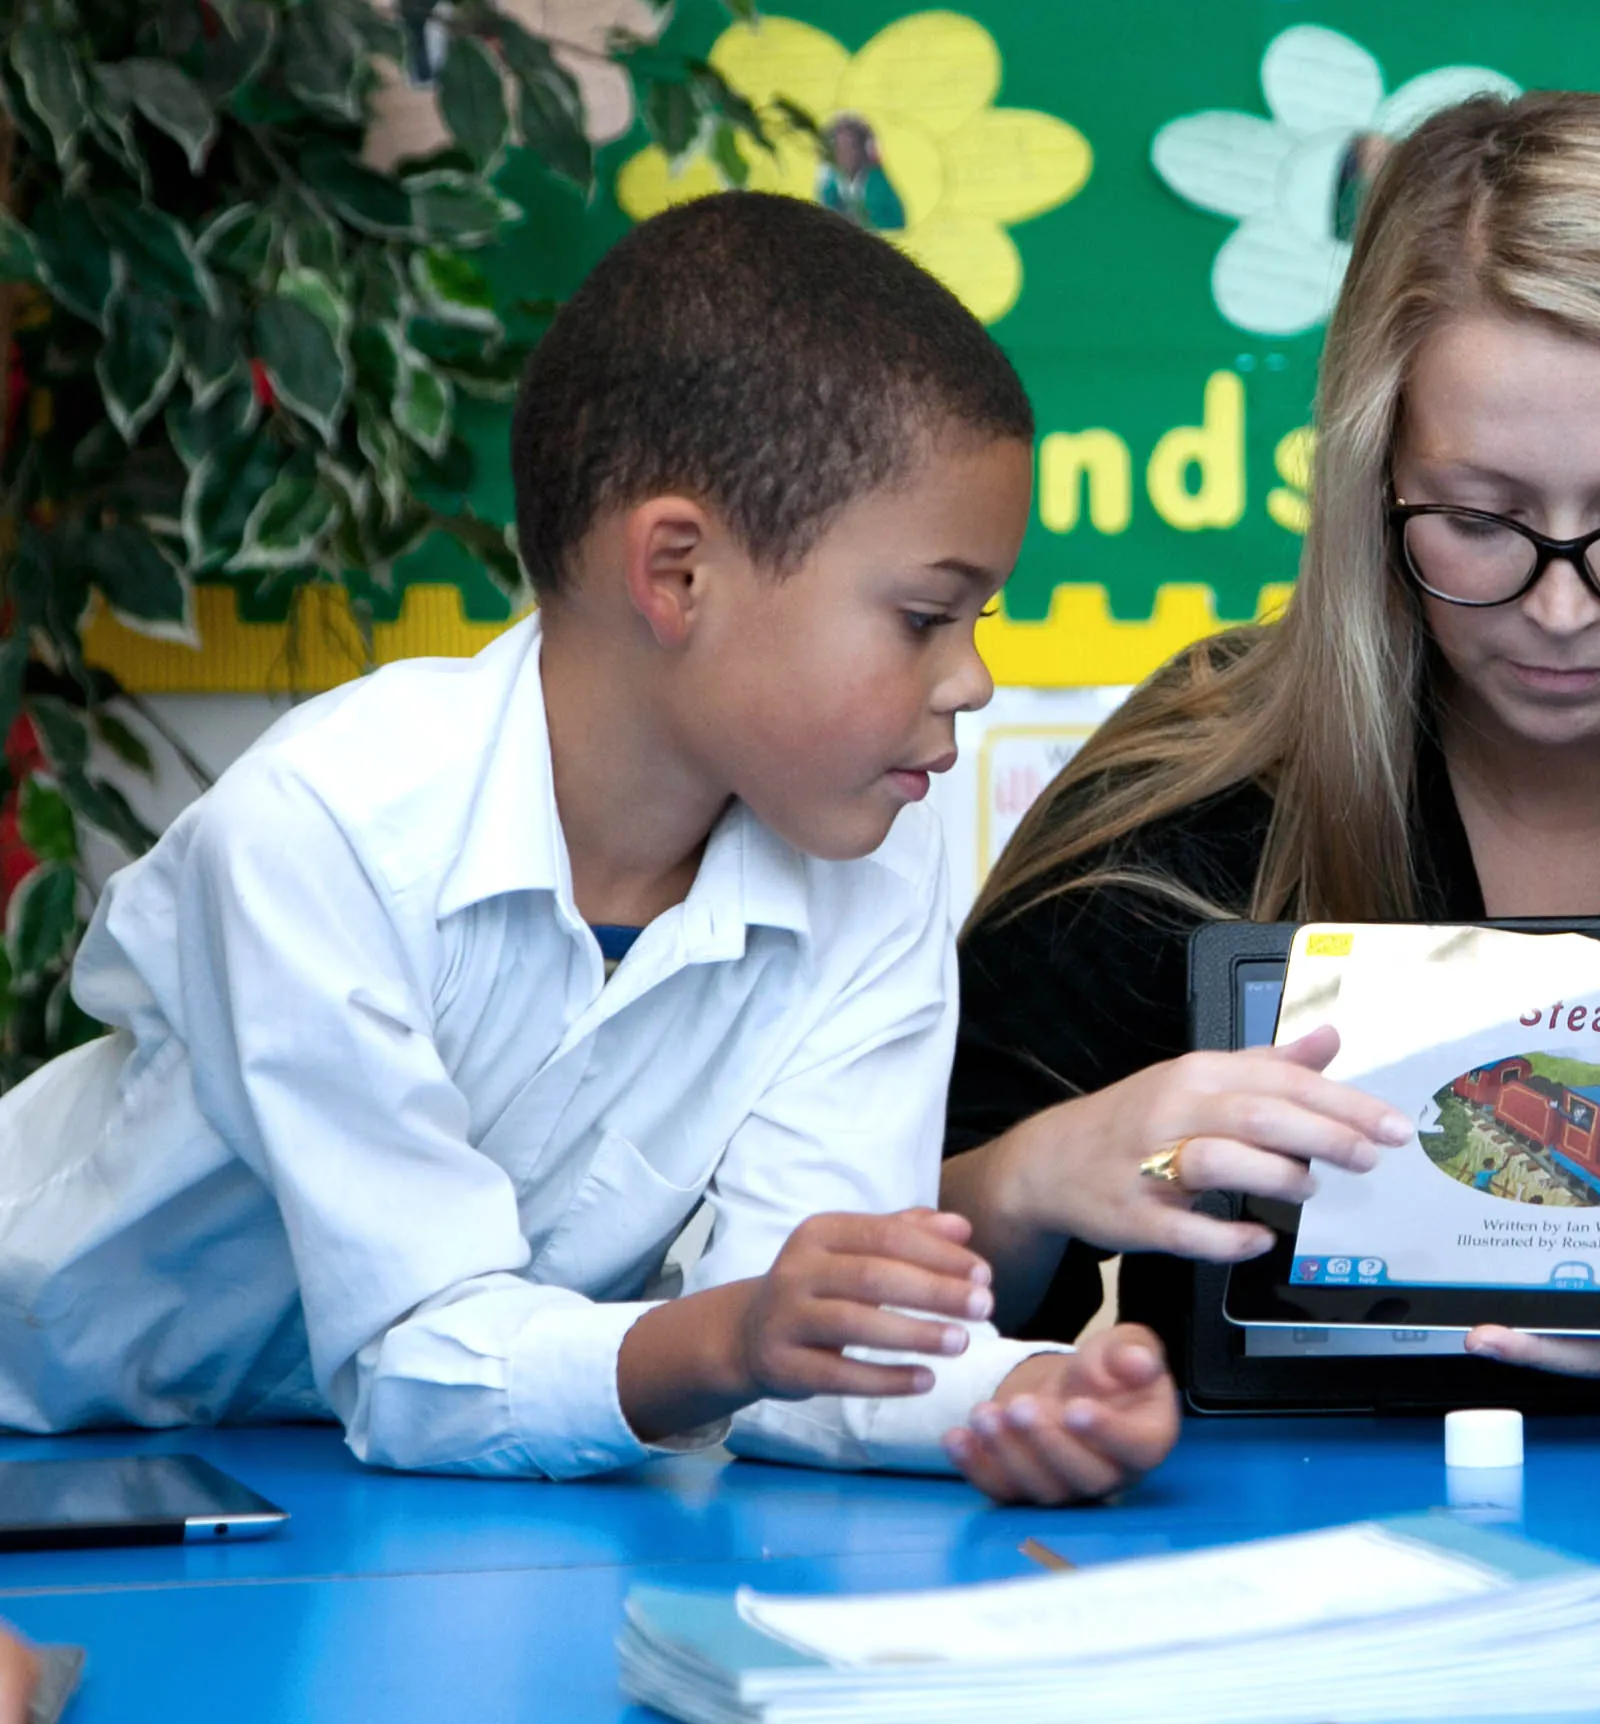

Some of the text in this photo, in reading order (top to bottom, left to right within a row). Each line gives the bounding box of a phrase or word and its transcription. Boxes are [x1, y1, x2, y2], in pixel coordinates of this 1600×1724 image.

[1483, 1219, 1537, 1232] Written
[1543, 1219, 1561, 1235] by
[1567, 1221, 1590, 1233] Ian
[1457, 1235, 1533, 1249] Illustrated
[1538, 1236, 1555, 1252] by
